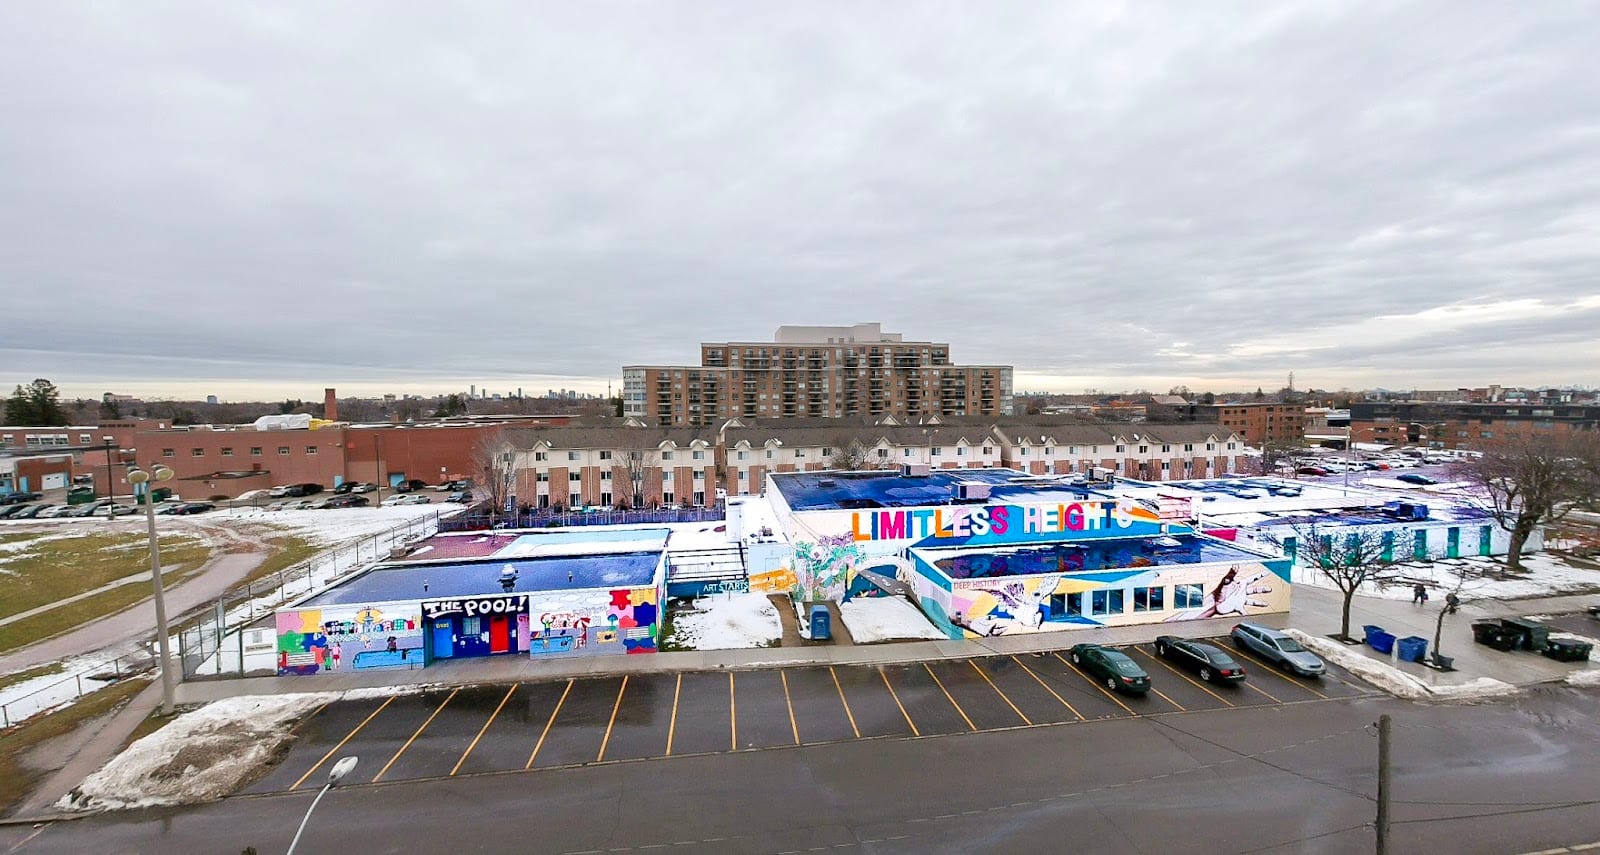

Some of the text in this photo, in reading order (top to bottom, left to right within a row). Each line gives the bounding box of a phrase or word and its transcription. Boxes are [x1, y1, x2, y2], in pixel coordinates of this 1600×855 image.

[852, 501, 1133, 541] LIMITLESS HEIGHTS
[703, 581, 749, 592] ART STARTS
[954, 581, 971, 589] DEEP
[422, 596, 527, 616] THE POOL!
